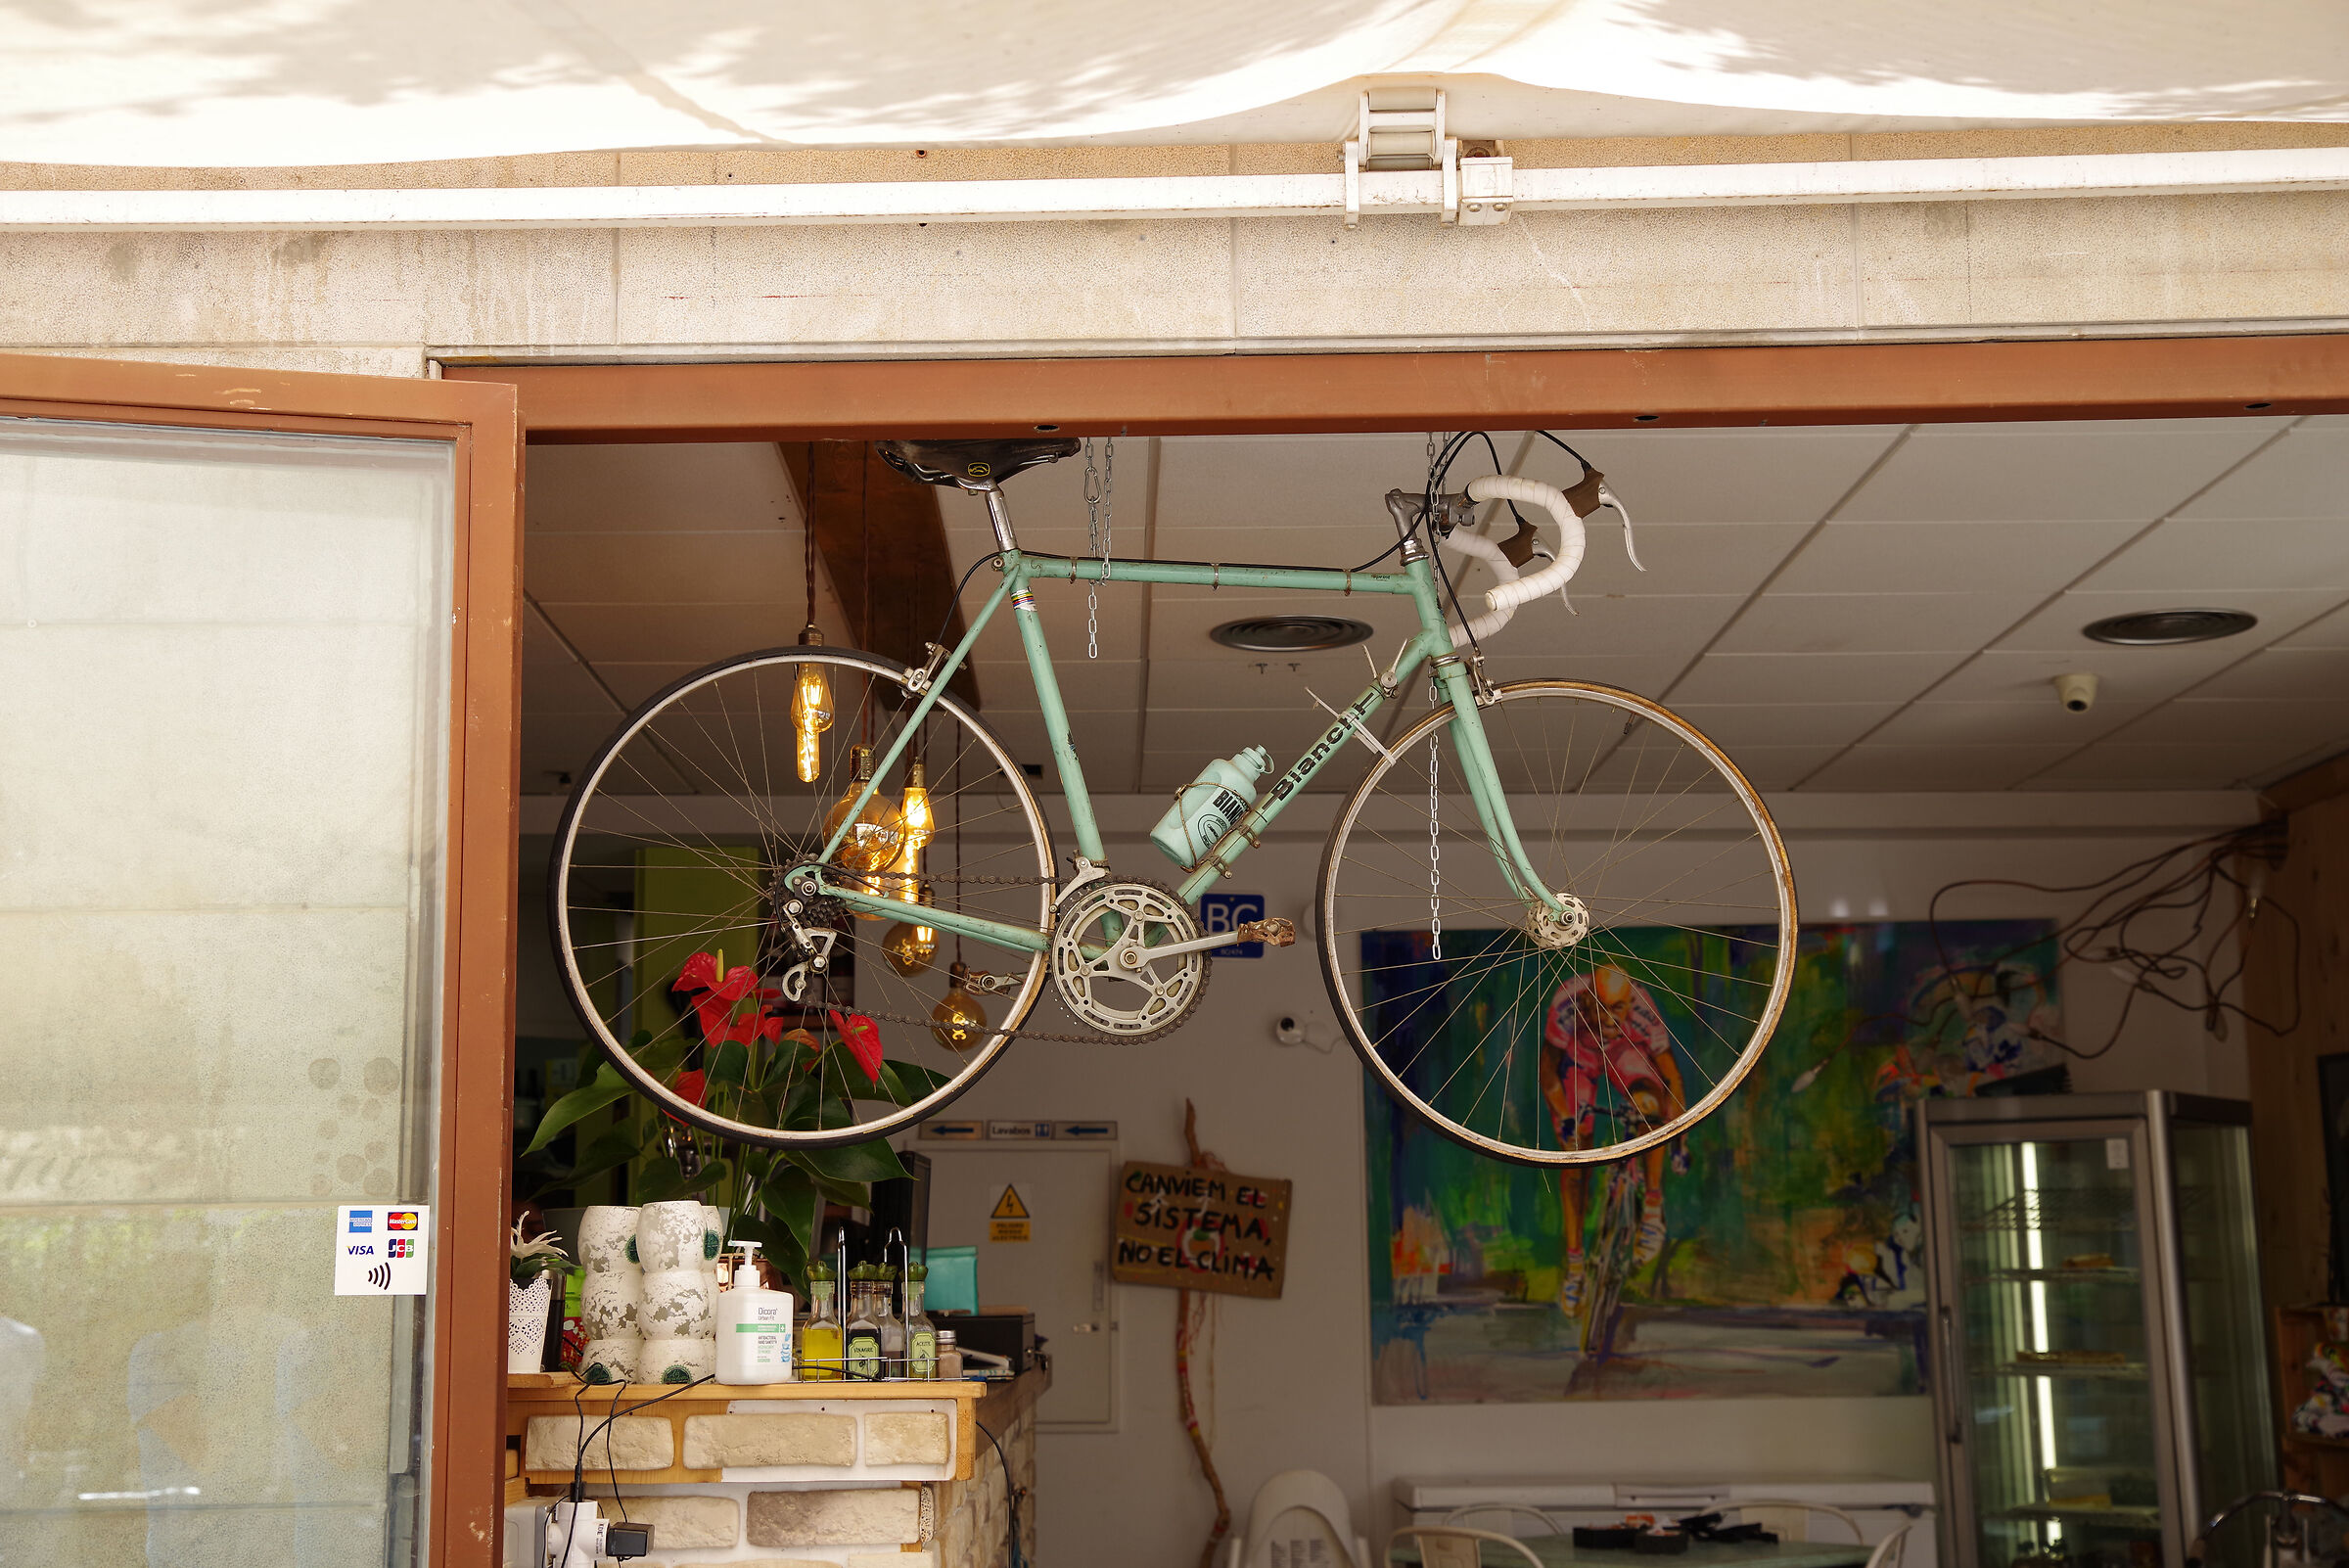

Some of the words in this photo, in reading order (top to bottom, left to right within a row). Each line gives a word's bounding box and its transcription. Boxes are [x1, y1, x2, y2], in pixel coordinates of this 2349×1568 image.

[991, 1125, 1031, 1135] Lavabos
[1236, 1186, 1267, 1209] EL
[345, 1245, 374, 1255] VISA
[1118, 1241, 1152, 1265] NO
[1158, 1247, 1188, 1268] EL
[758, 1307, 777, 1315] Dicora
